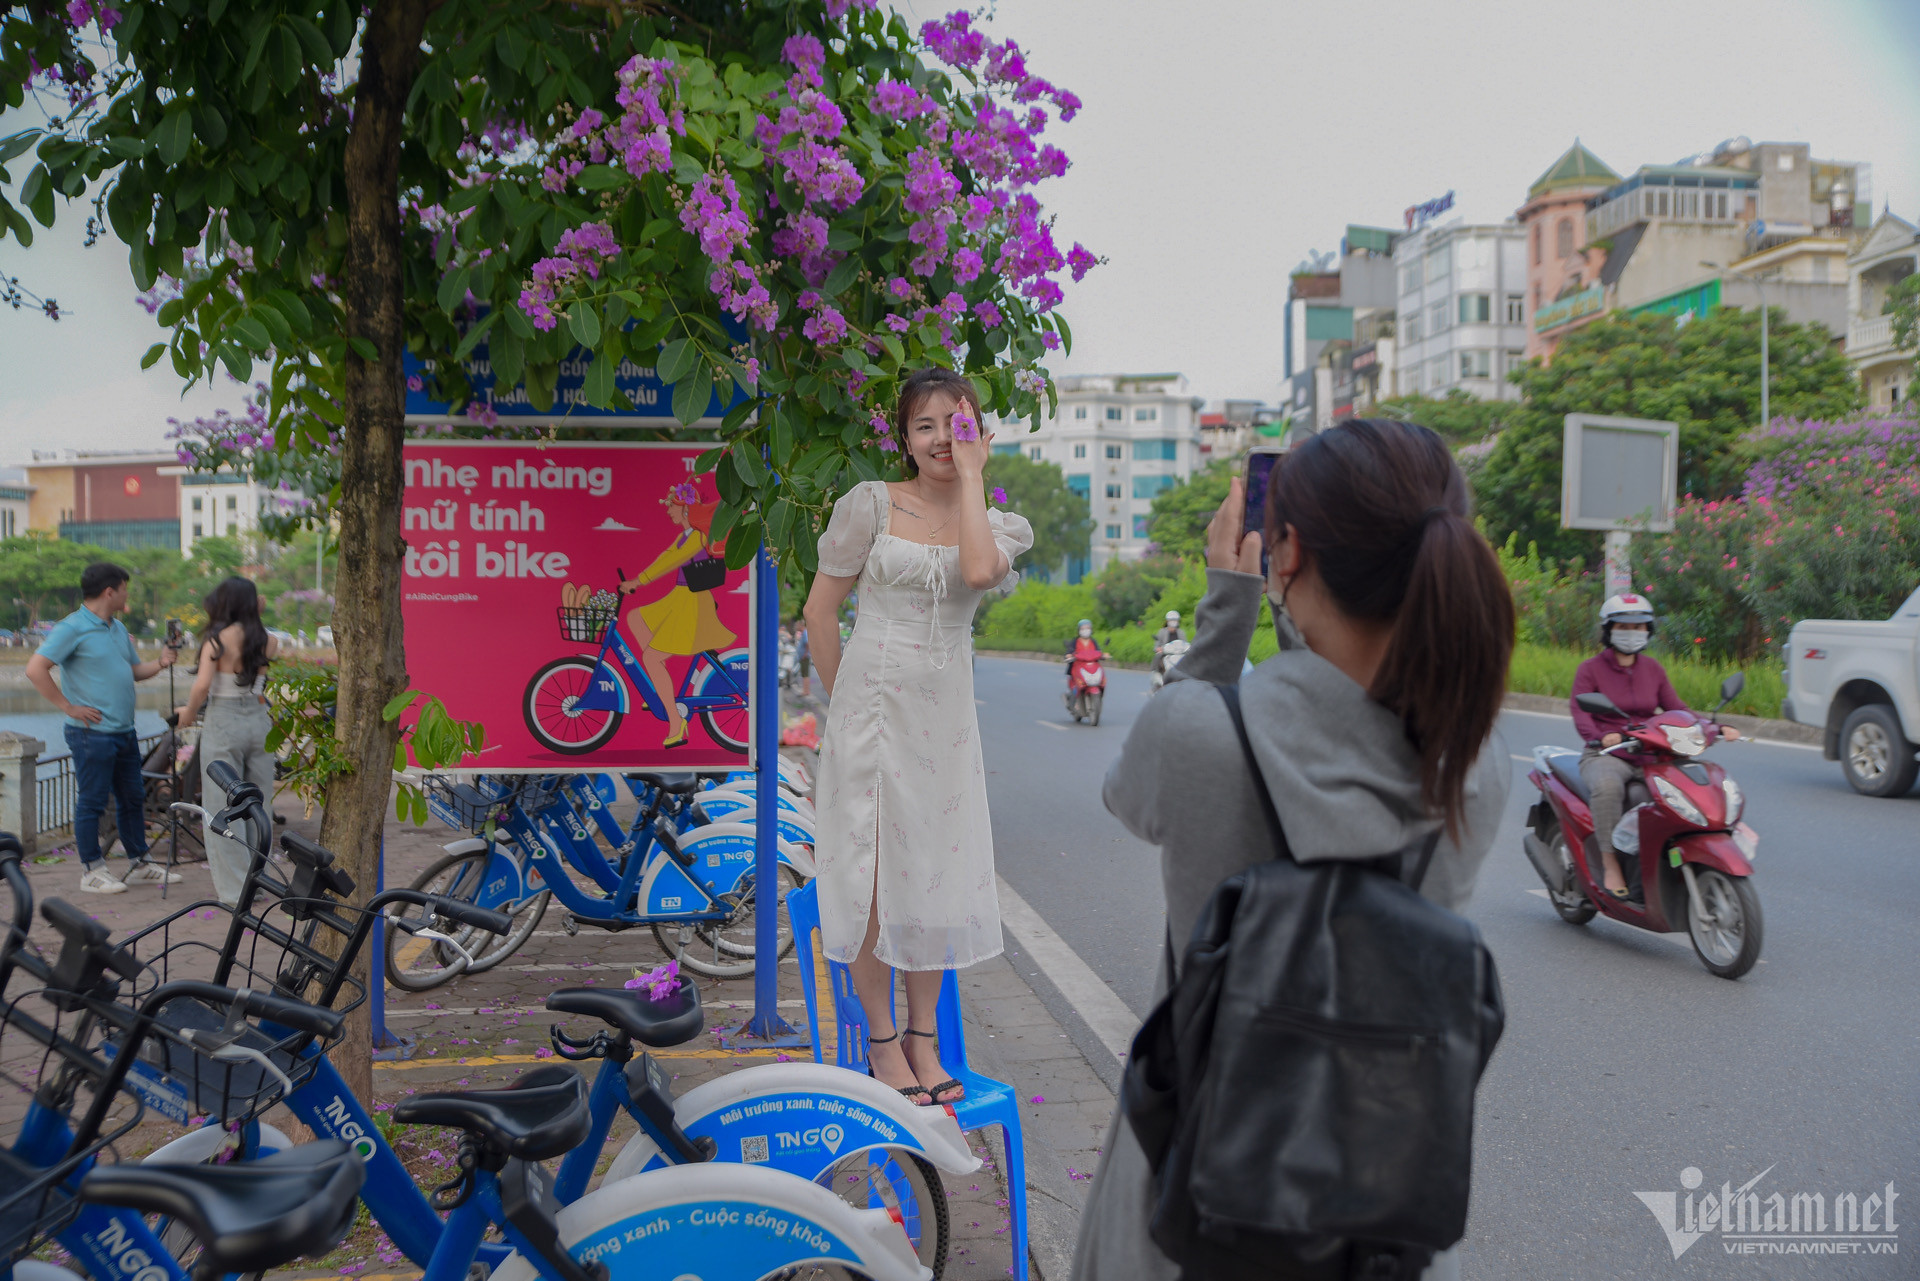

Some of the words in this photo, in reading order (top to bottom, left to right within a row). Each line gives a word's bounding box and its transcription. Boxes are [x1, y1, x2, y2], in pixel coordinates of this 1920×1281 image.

[492, 458, 612, 496] nhàng
[404, 498, 458, 530] nữ
[470, 498, 545, 531] tính
[404, 540, 460, 578] tôi
[476, 540, 571, 578] bike
[598, 680, 615, 691] TN
[719, 1109, 743, 1126] Môi
[744, 1100, 784, 1117] trường
[818, 1098, 844, 1116] Cuộc
[845, 1106, 873, 1127] sống
[623, 1217, 670, 1244] xanh
[690, 1208, 739, 1228] Cuộc
[744, 1204, 788, 1235] sống
[790, 1219, 831, 1253] khỏe
